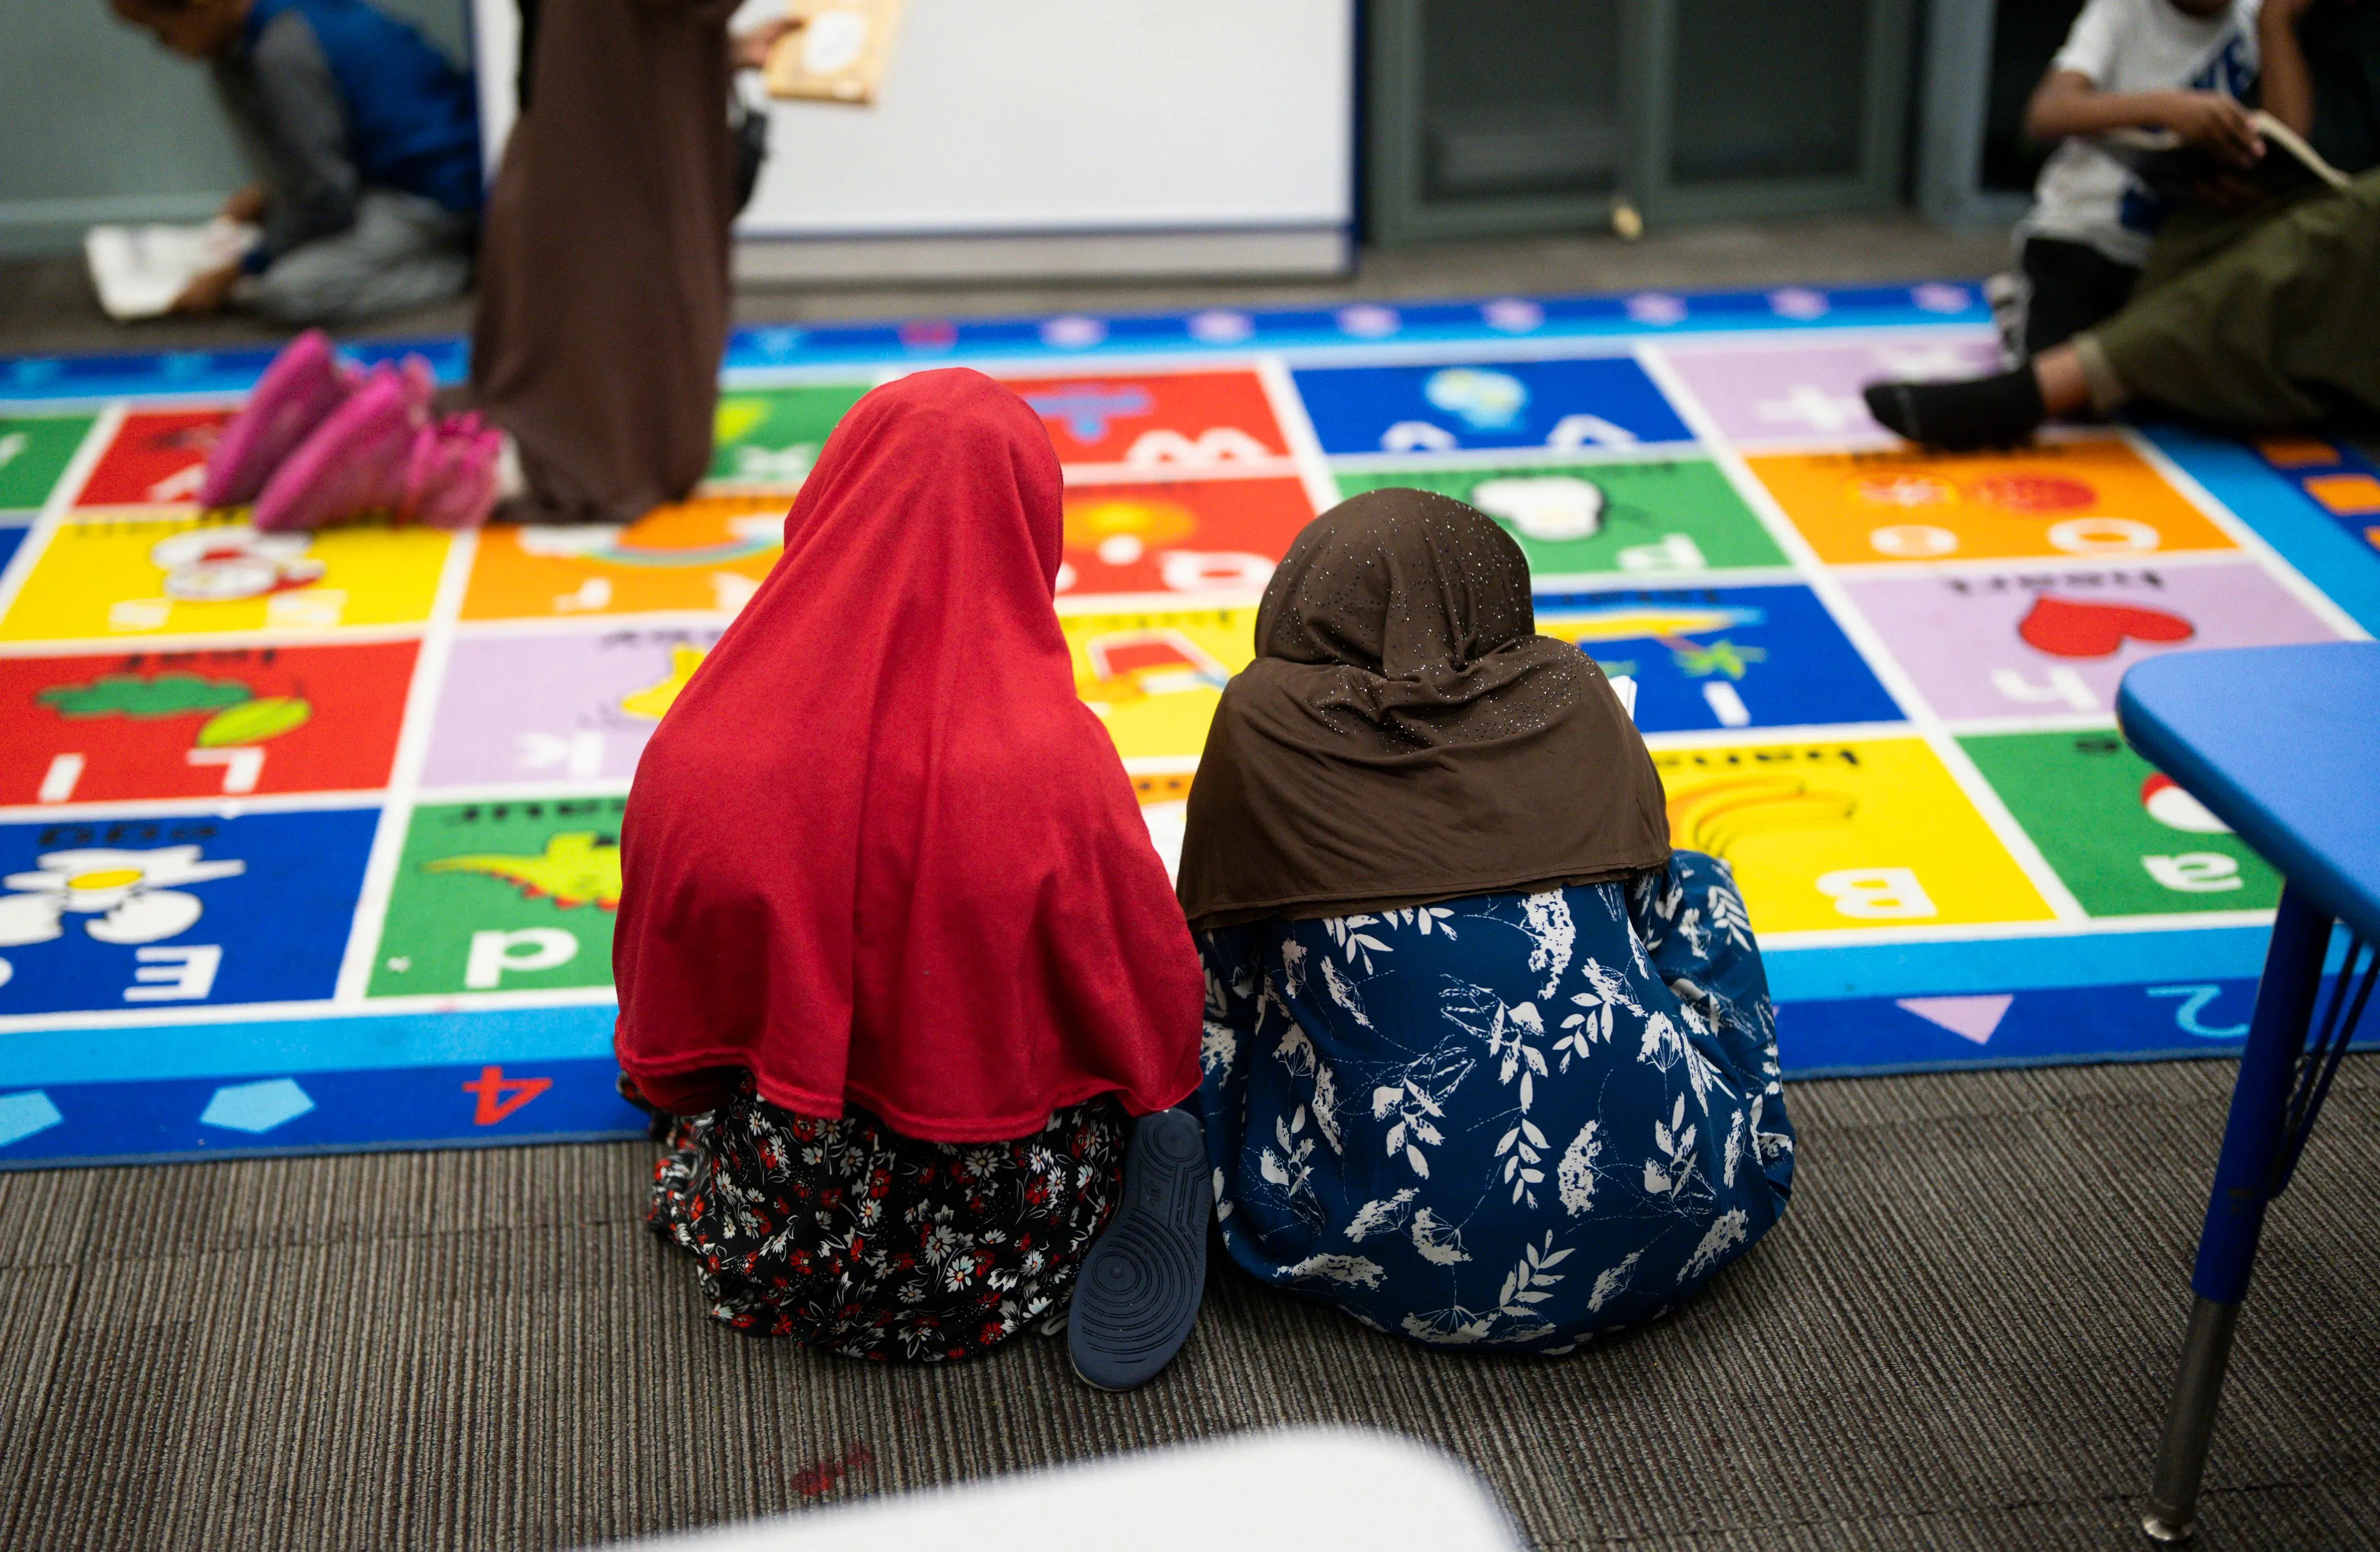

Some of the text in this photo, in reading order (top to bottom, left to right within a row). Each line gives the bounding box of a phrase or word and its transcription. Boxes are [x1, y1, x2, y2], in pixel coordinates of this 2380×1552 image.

[187, 747, 264, 793] L
[1652, 749, 1858, 770] bana
[1814, 866, 1938, 918] B
[2140, 851, 2244, 894] a
[123, 943, 223, 1002] E
[465, 927, 578, 989] d
[462, 1065, 553, 1125] 4
